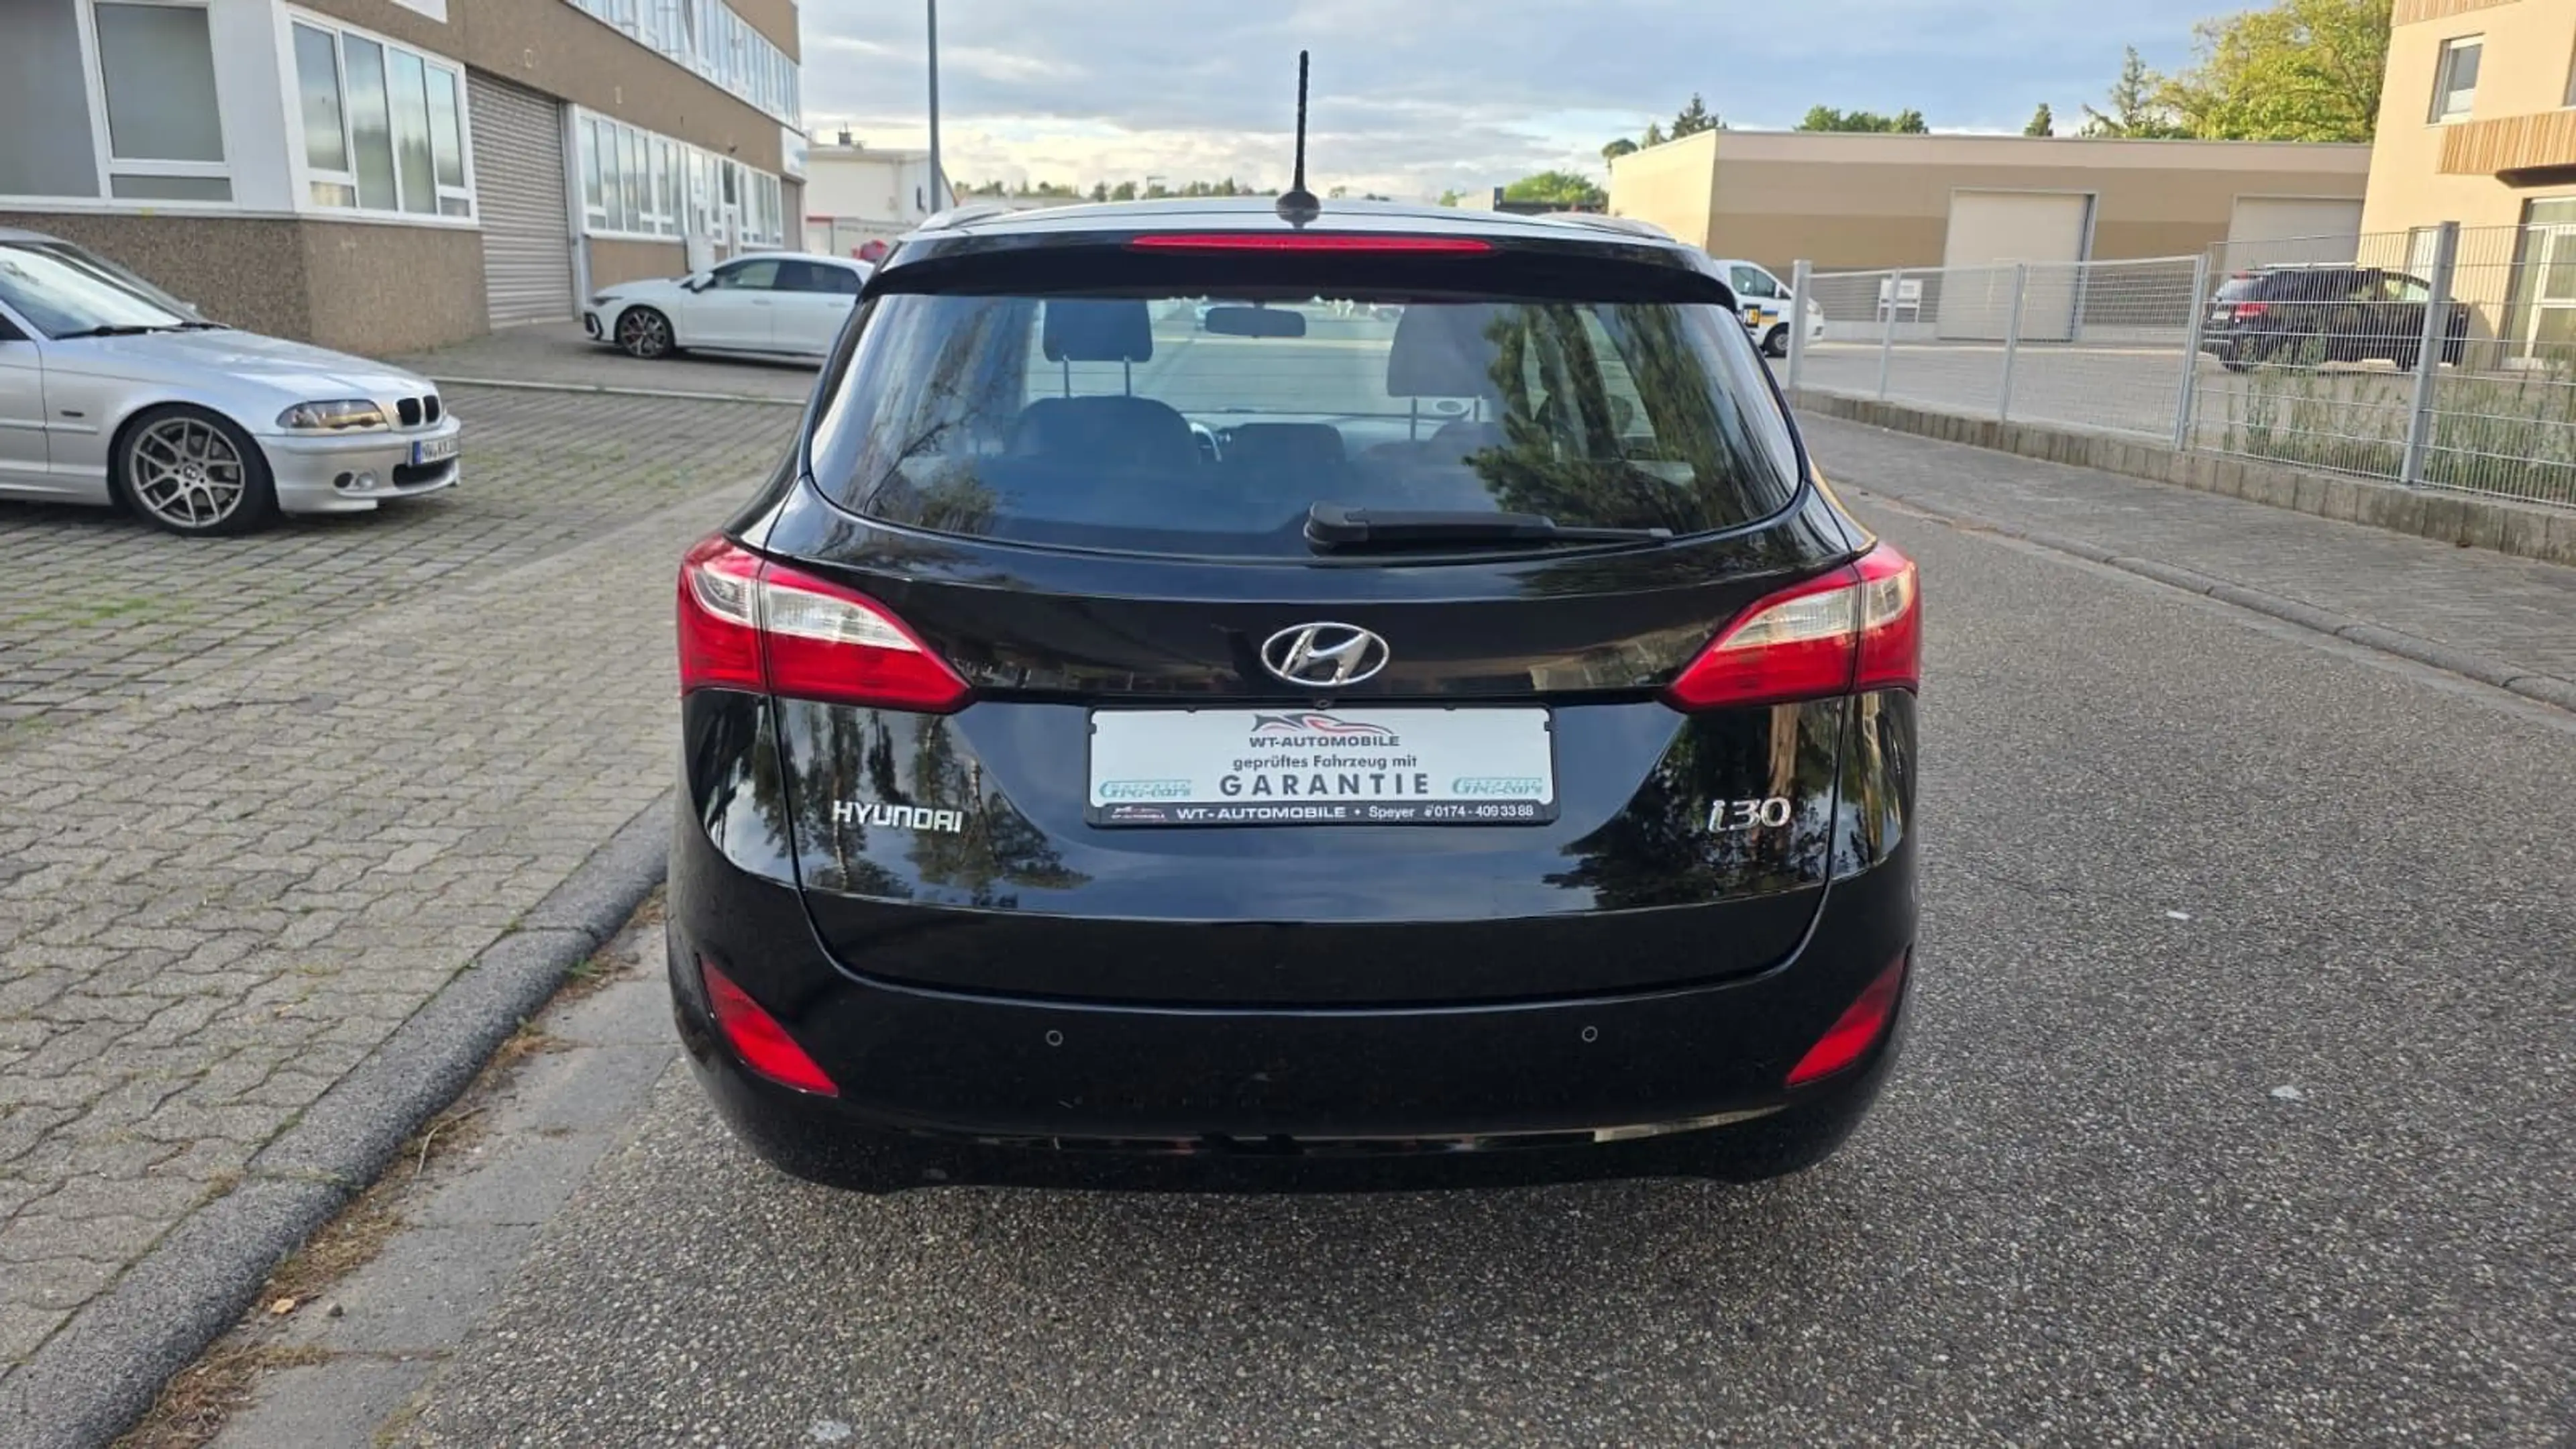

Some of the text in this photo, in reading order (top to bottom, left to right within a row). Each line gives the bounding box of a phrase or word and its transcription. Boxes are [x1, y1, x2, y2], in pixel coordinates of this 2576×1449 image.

[1249, 736, 1401, 748] WT-AUTOMOBILE
[1234, 754, 1417, 771] geprüftes Fahrzeug mit
[1220, 773, 1429, 796] GARANTIE
[832, 800, 963, 833] HYUNDAI
[1368, 806, 1415, 820] Speyer
[1709, 797, 1791, 833] i30
